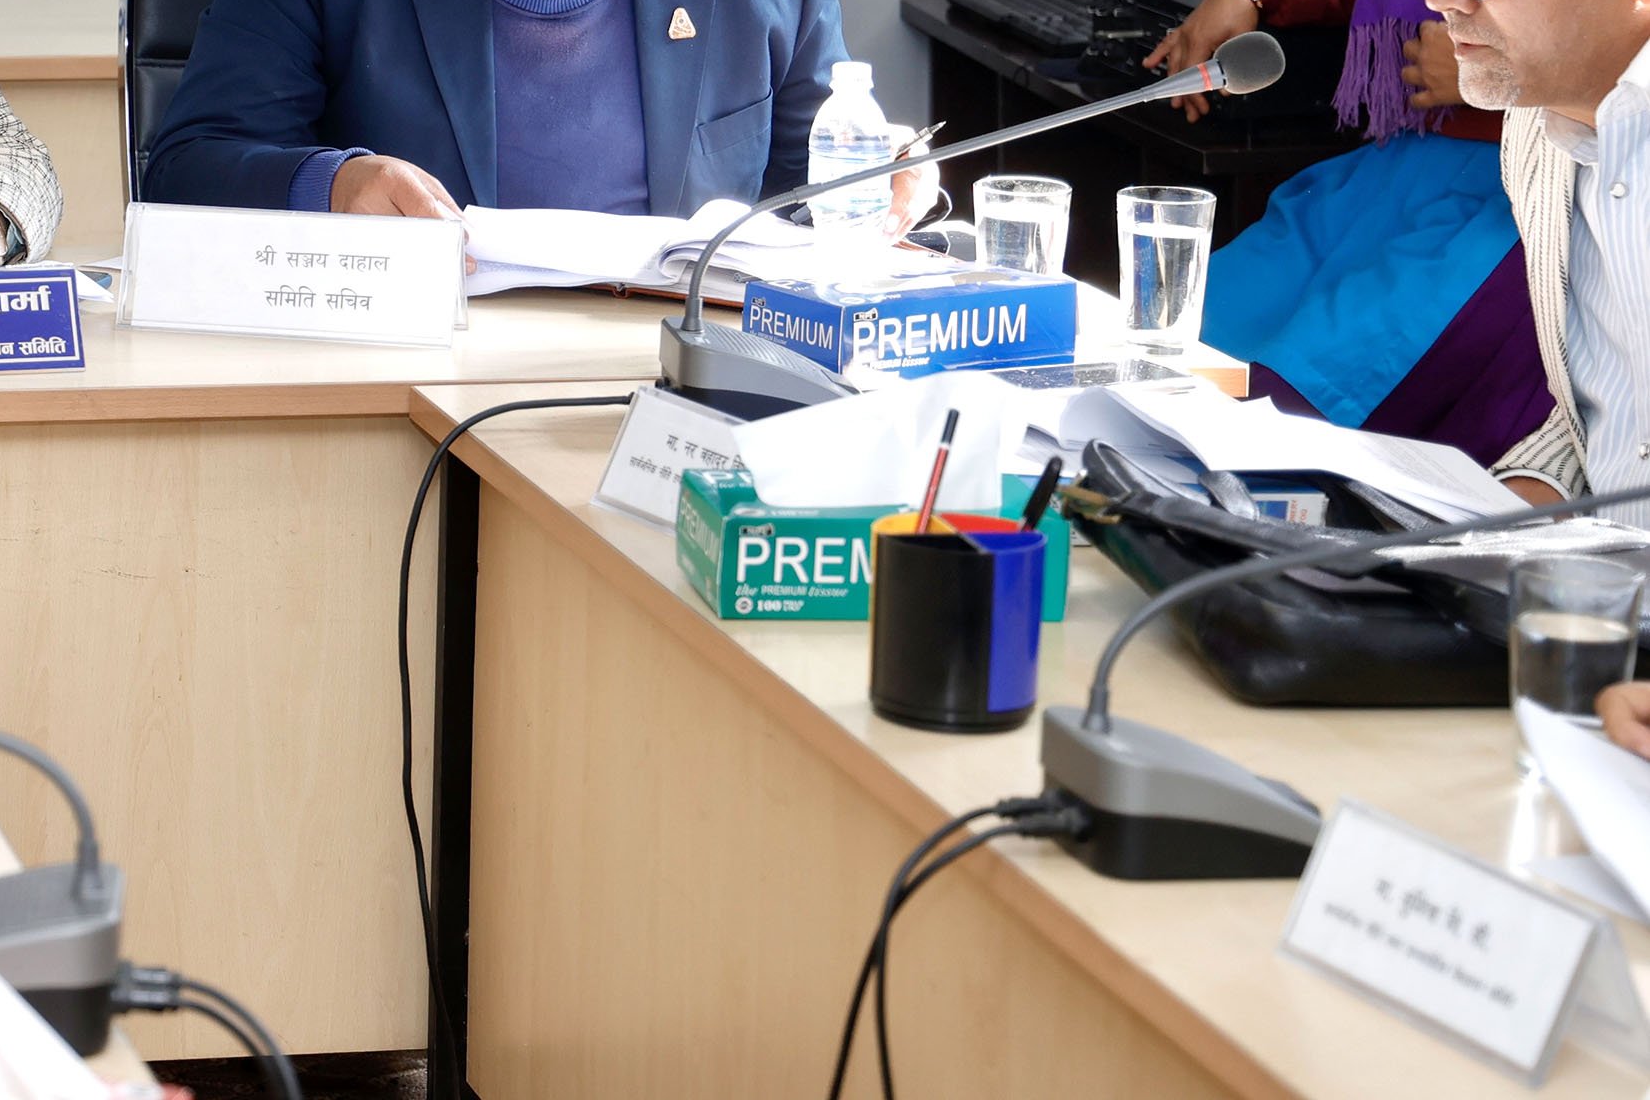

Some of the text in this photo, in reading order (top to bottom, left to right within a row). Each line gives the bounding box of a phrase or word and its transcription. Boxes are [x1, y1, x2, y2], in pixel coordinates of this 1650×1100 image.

[255, 244, 277, 267] श्री
[339, 254, 391, 272] दाहाल
[264, 285, 373, 311] समिति सचिव
[749, 305, 833, 350] PREMIUM
[853, 304, 1027, 359] PREMIUM
[18, 337, 67, 355] समिति
